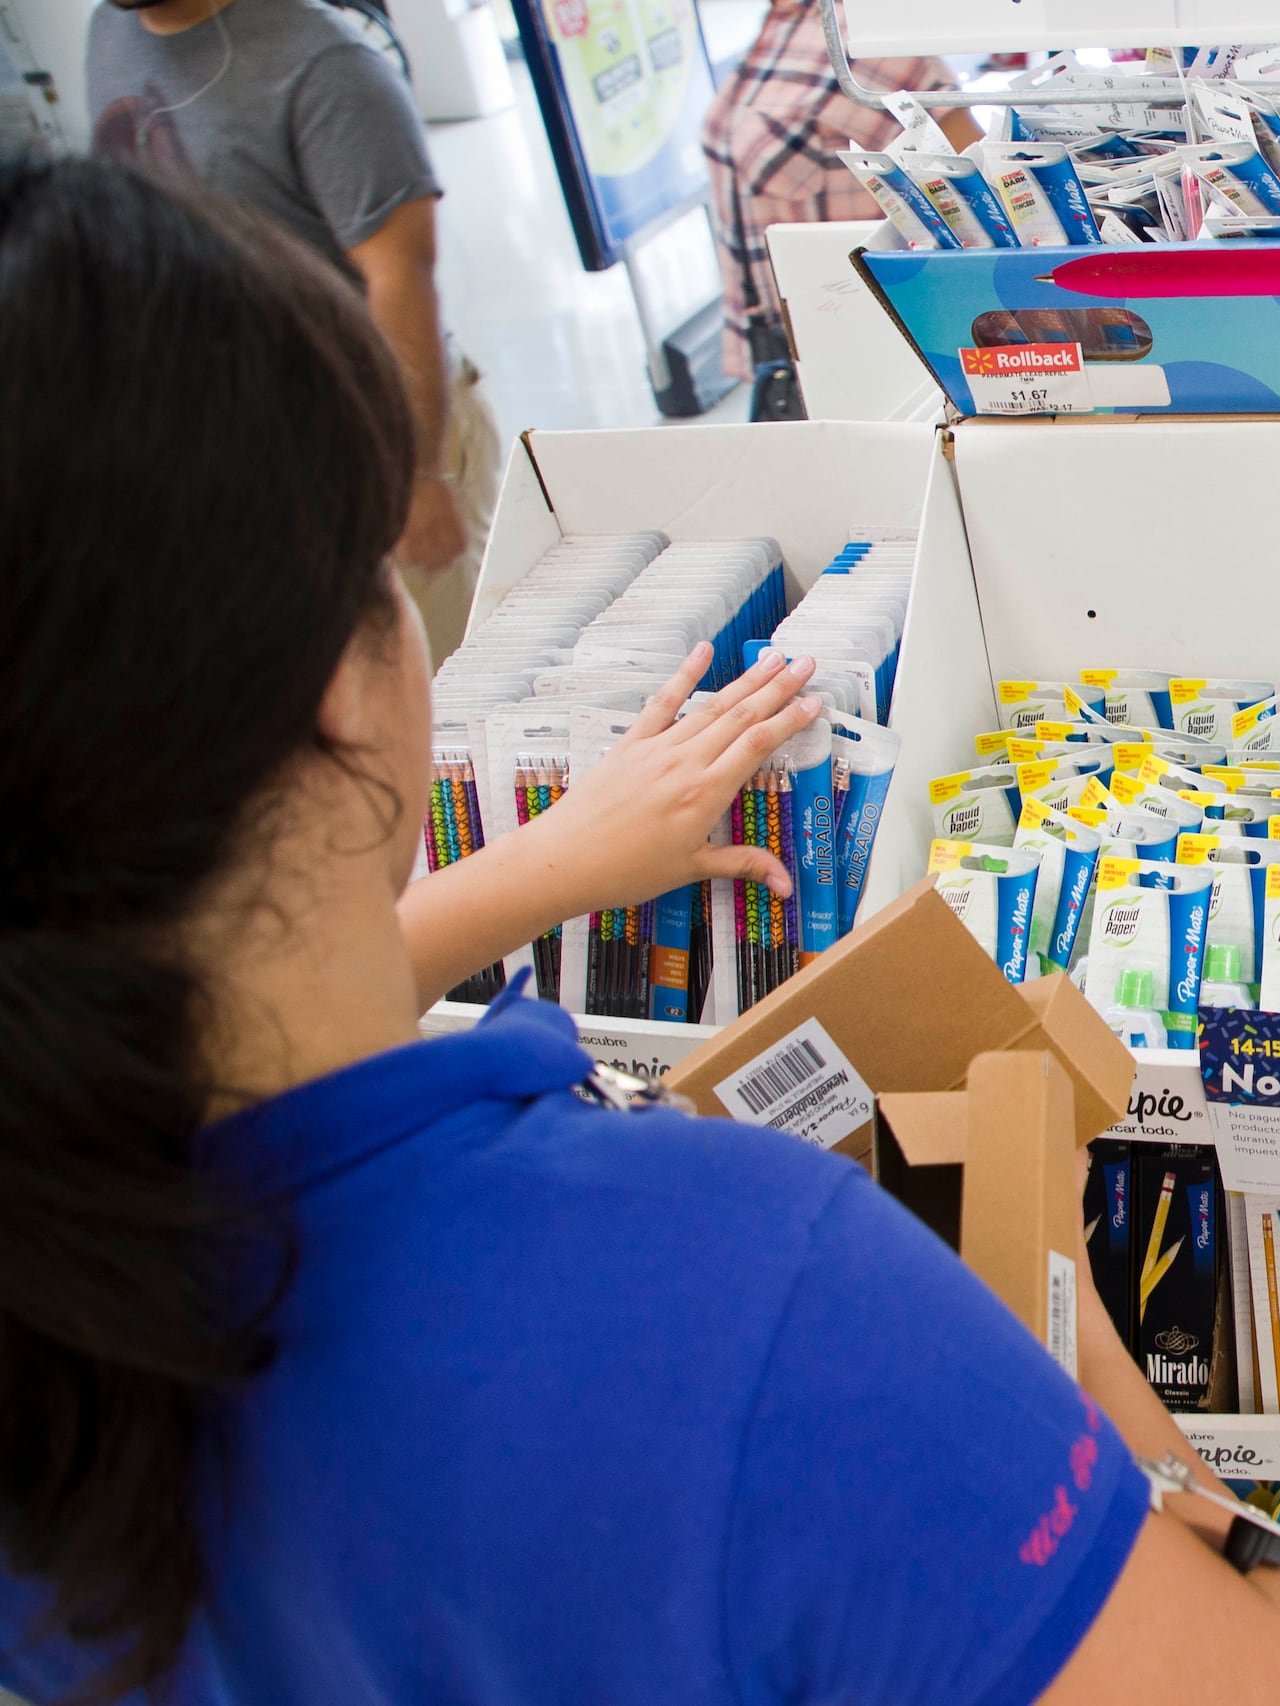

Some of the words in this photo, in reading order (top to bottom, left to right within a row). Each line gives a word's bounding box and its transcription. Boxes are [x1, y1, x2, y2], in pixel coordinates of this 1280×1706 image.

[997, 350, 1074, 368] Rollback
[1011, 390, 1048, 401] $1.67
[1188, 713, 1215, 726] Liquid
[1188, 723, 1213, 735] Paper
[950, 807, 980, 824] Liquid
[950, 818, 979, 834] Paper
[815, 797, 833, 885] MIRADO
[845, 804, 878, 890] MIRADO
[1109, 908, 1140, 922] Liquid
[1105, 921, 1135, 935] Paper
[1186, 906, 1204, 948] Mate
[1177, 953, 1200, 1003] Paper
[1222, 1062, 1280, 1096] No
[1228, 1111, 1246, 1119] No
[1142, 1125, 1178, 1136] todo.
[1233, 1134, 1277, 1145] durante
[1146, 1353, 1208, 1385] Mirado
